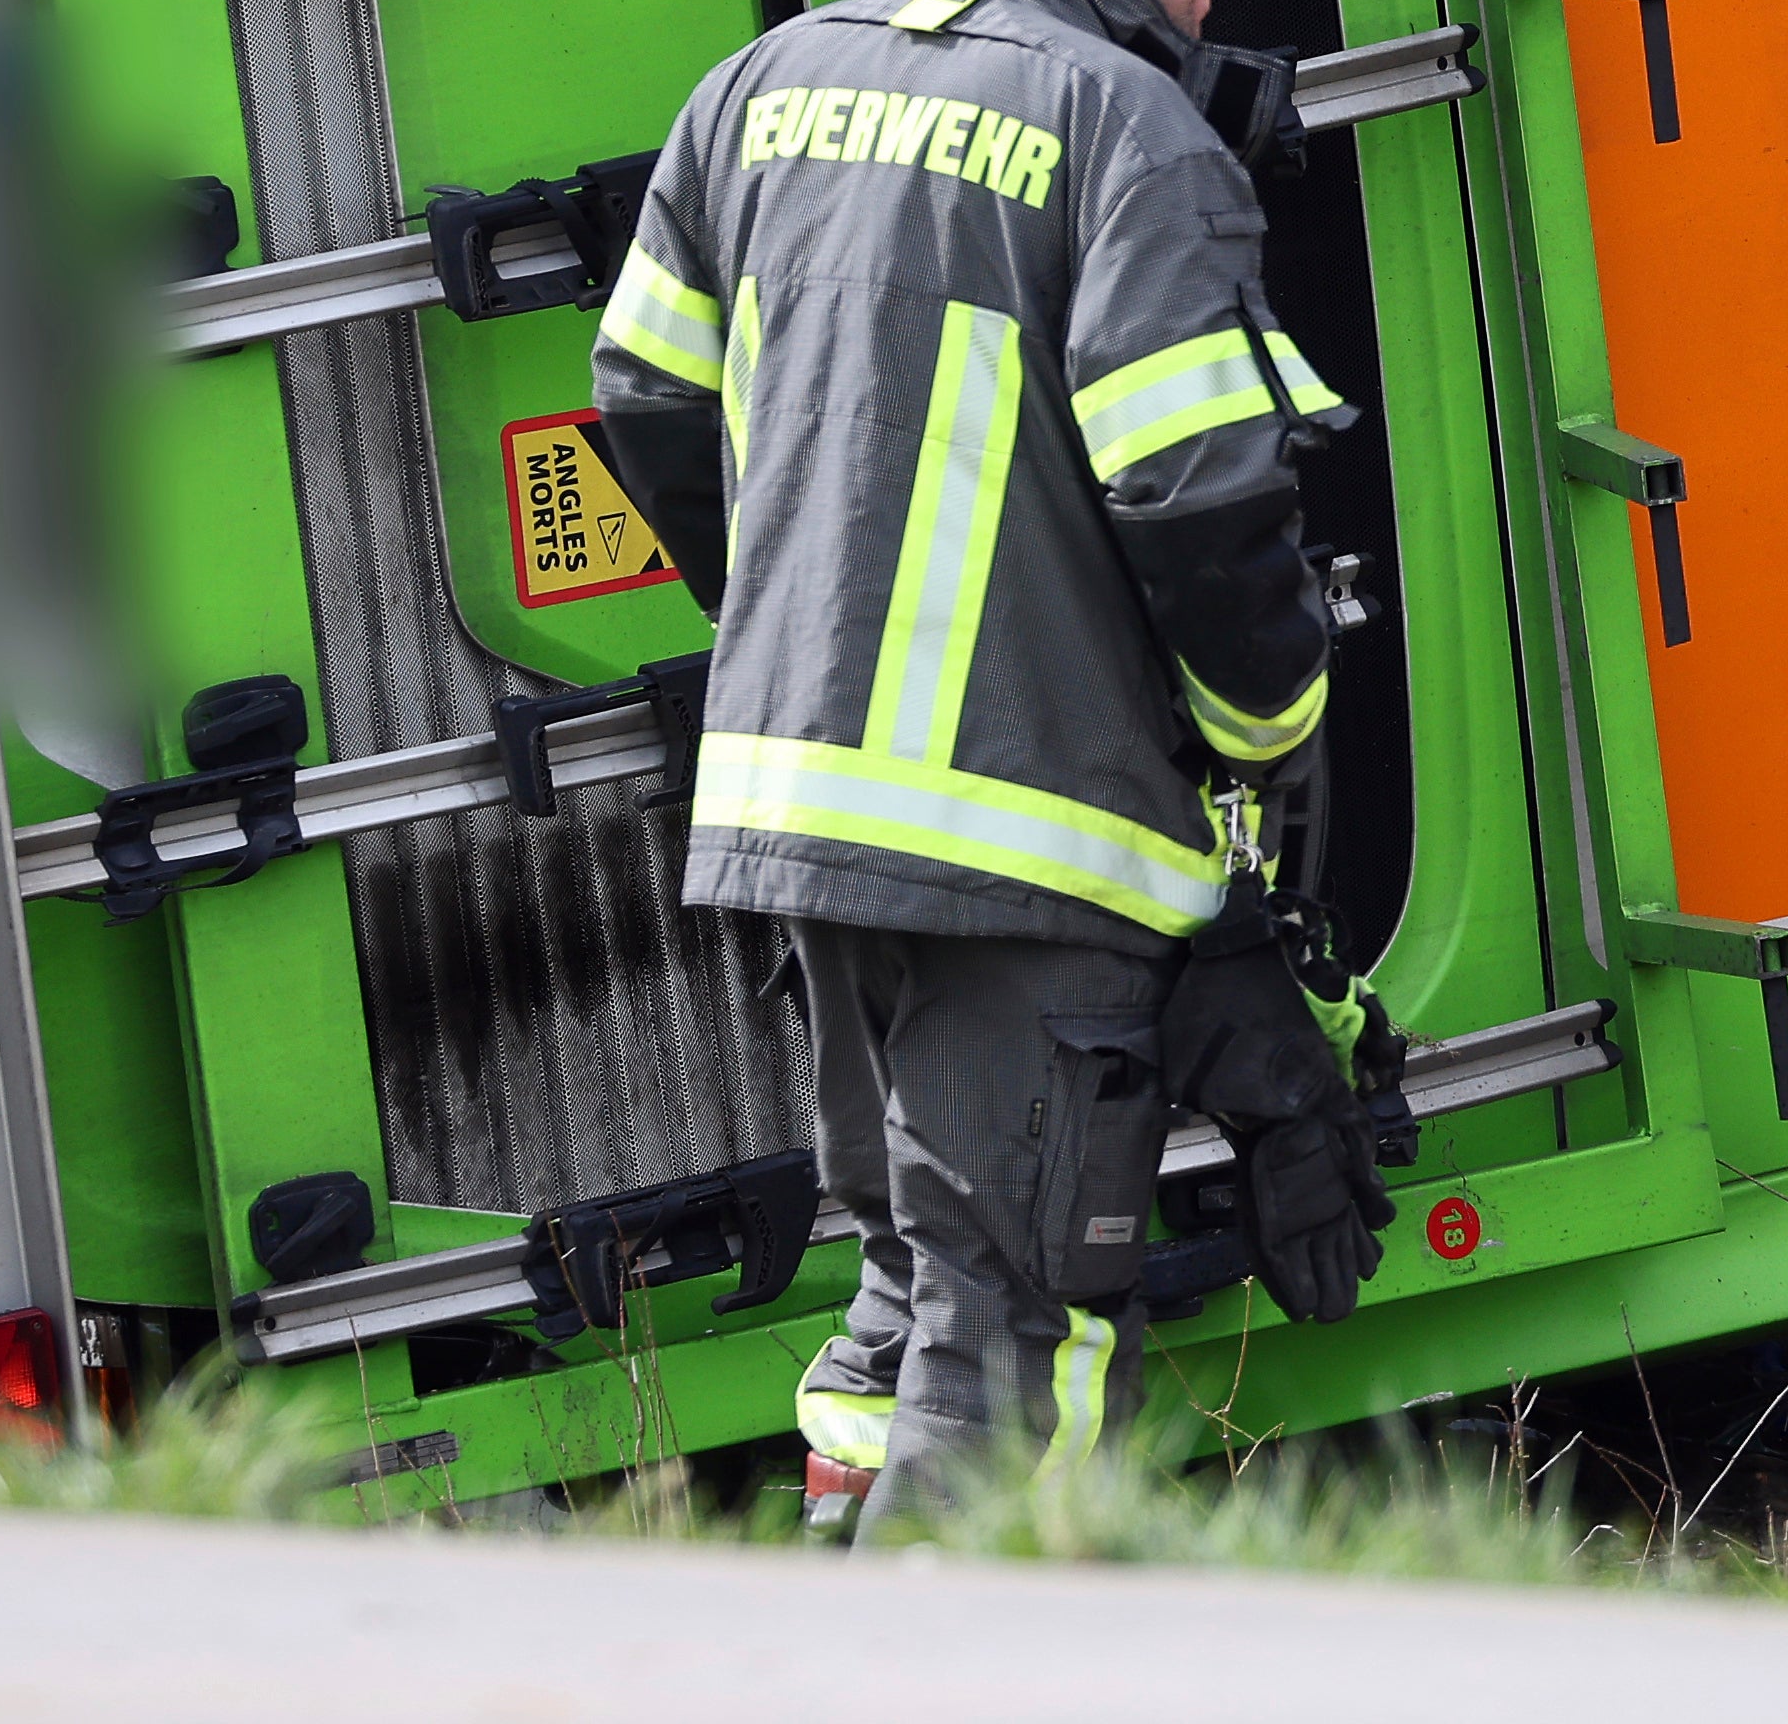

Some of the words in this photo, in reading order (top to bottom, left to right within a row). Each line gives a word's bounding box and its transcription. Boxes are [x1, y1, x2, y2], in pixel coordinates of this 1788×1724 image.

[741, 86, 1062, 210] FEUERWEHR
[526, 453, 560, 571] MORTS
[552, 443, 587, 572] ANGLES
[1441, 1208, 1465, 1248] 18
